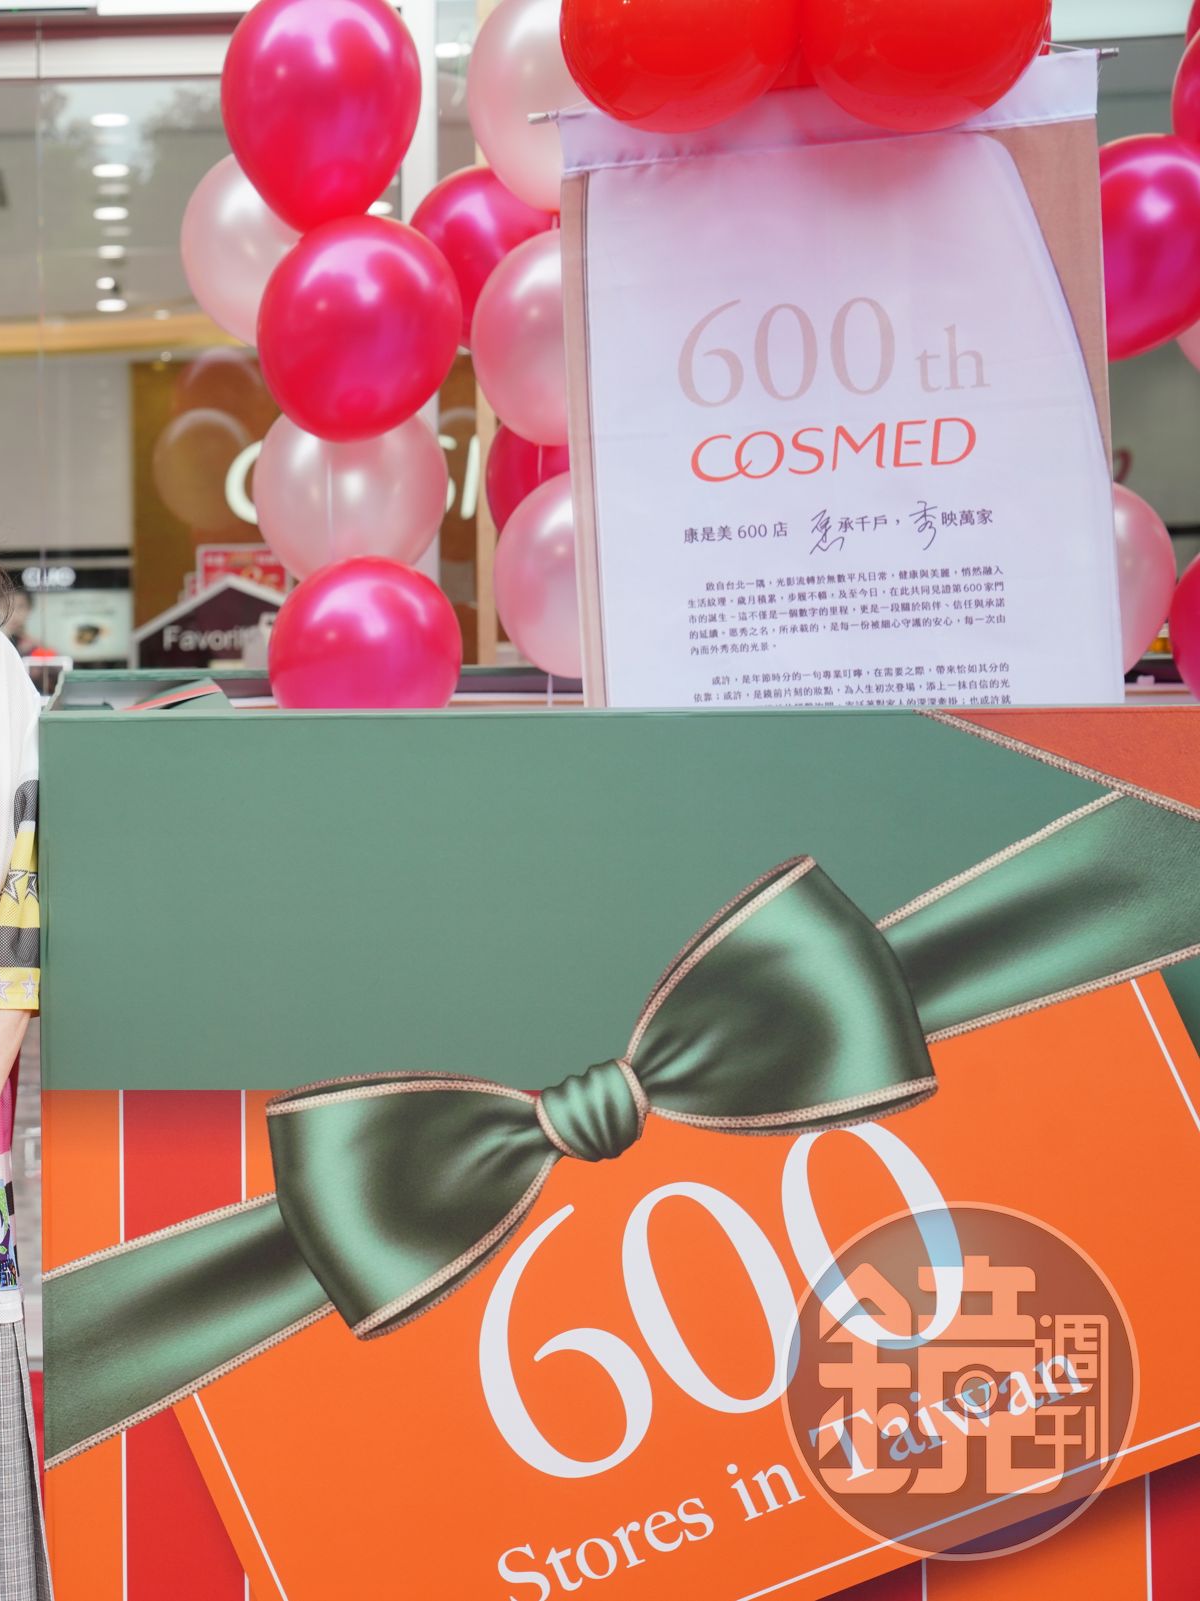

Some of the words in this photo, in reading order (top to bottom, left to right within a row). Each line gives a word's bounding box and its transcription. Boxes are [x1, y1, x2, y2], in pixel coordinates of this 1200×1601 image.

[677, 296, 896, 408] 600
[915, 323, 991, 394] th
[691, 417, 976, 482] COSMED
[683, 525, 733, 544] 康是美
[737, 523, 768, 539] 600
[772, 521, 789, 538] 店
[478, 1120, 963, 1479] 600
[497, 1497, 714, 1601] Stores
[726, 1463, 806, 1523] in
[809, 1351, 1089, 1483] Taiwan
